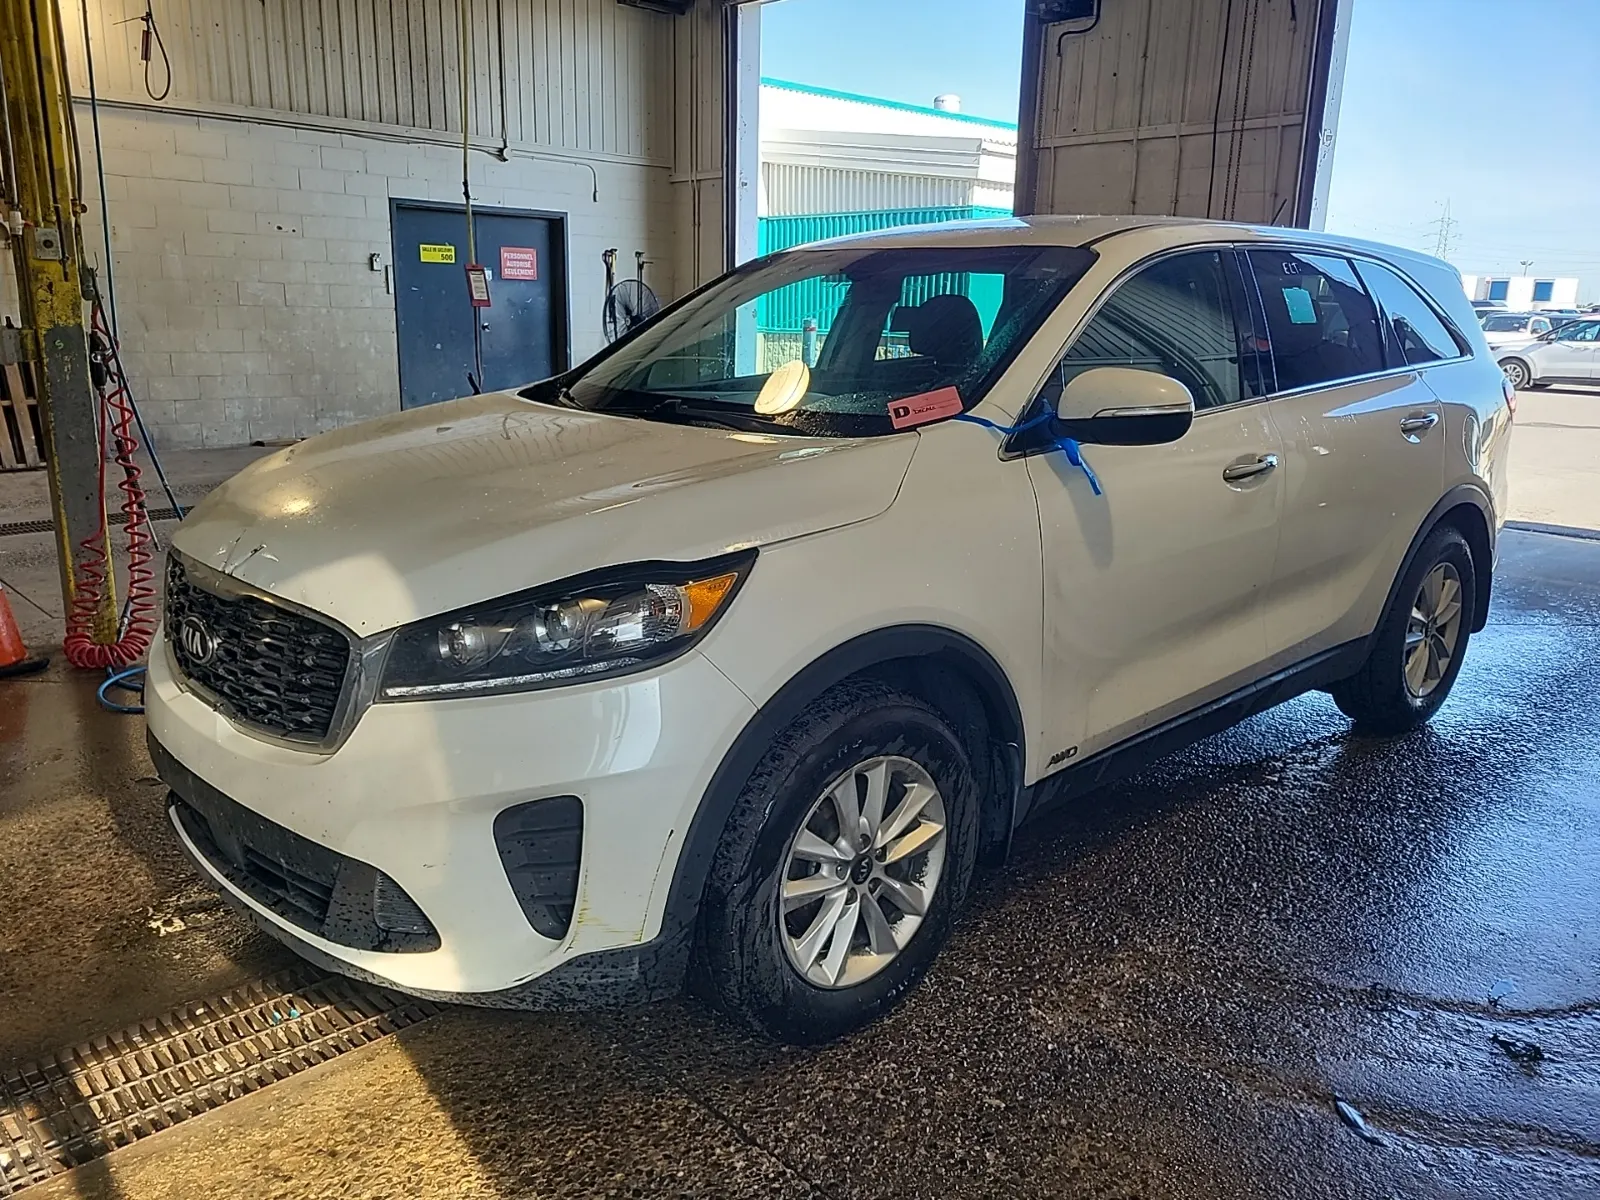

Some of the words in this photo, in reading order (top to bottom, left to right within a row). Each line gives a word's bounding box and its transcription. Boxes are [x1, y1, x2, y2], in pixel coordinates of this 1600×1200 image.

[504, 252, 533, 261] PERSONNEL
[504, 268, 534, 276] SEULEMENT
[183, 624, 204, 657] KIA
[1045, 745, 1078, 770] AWD
